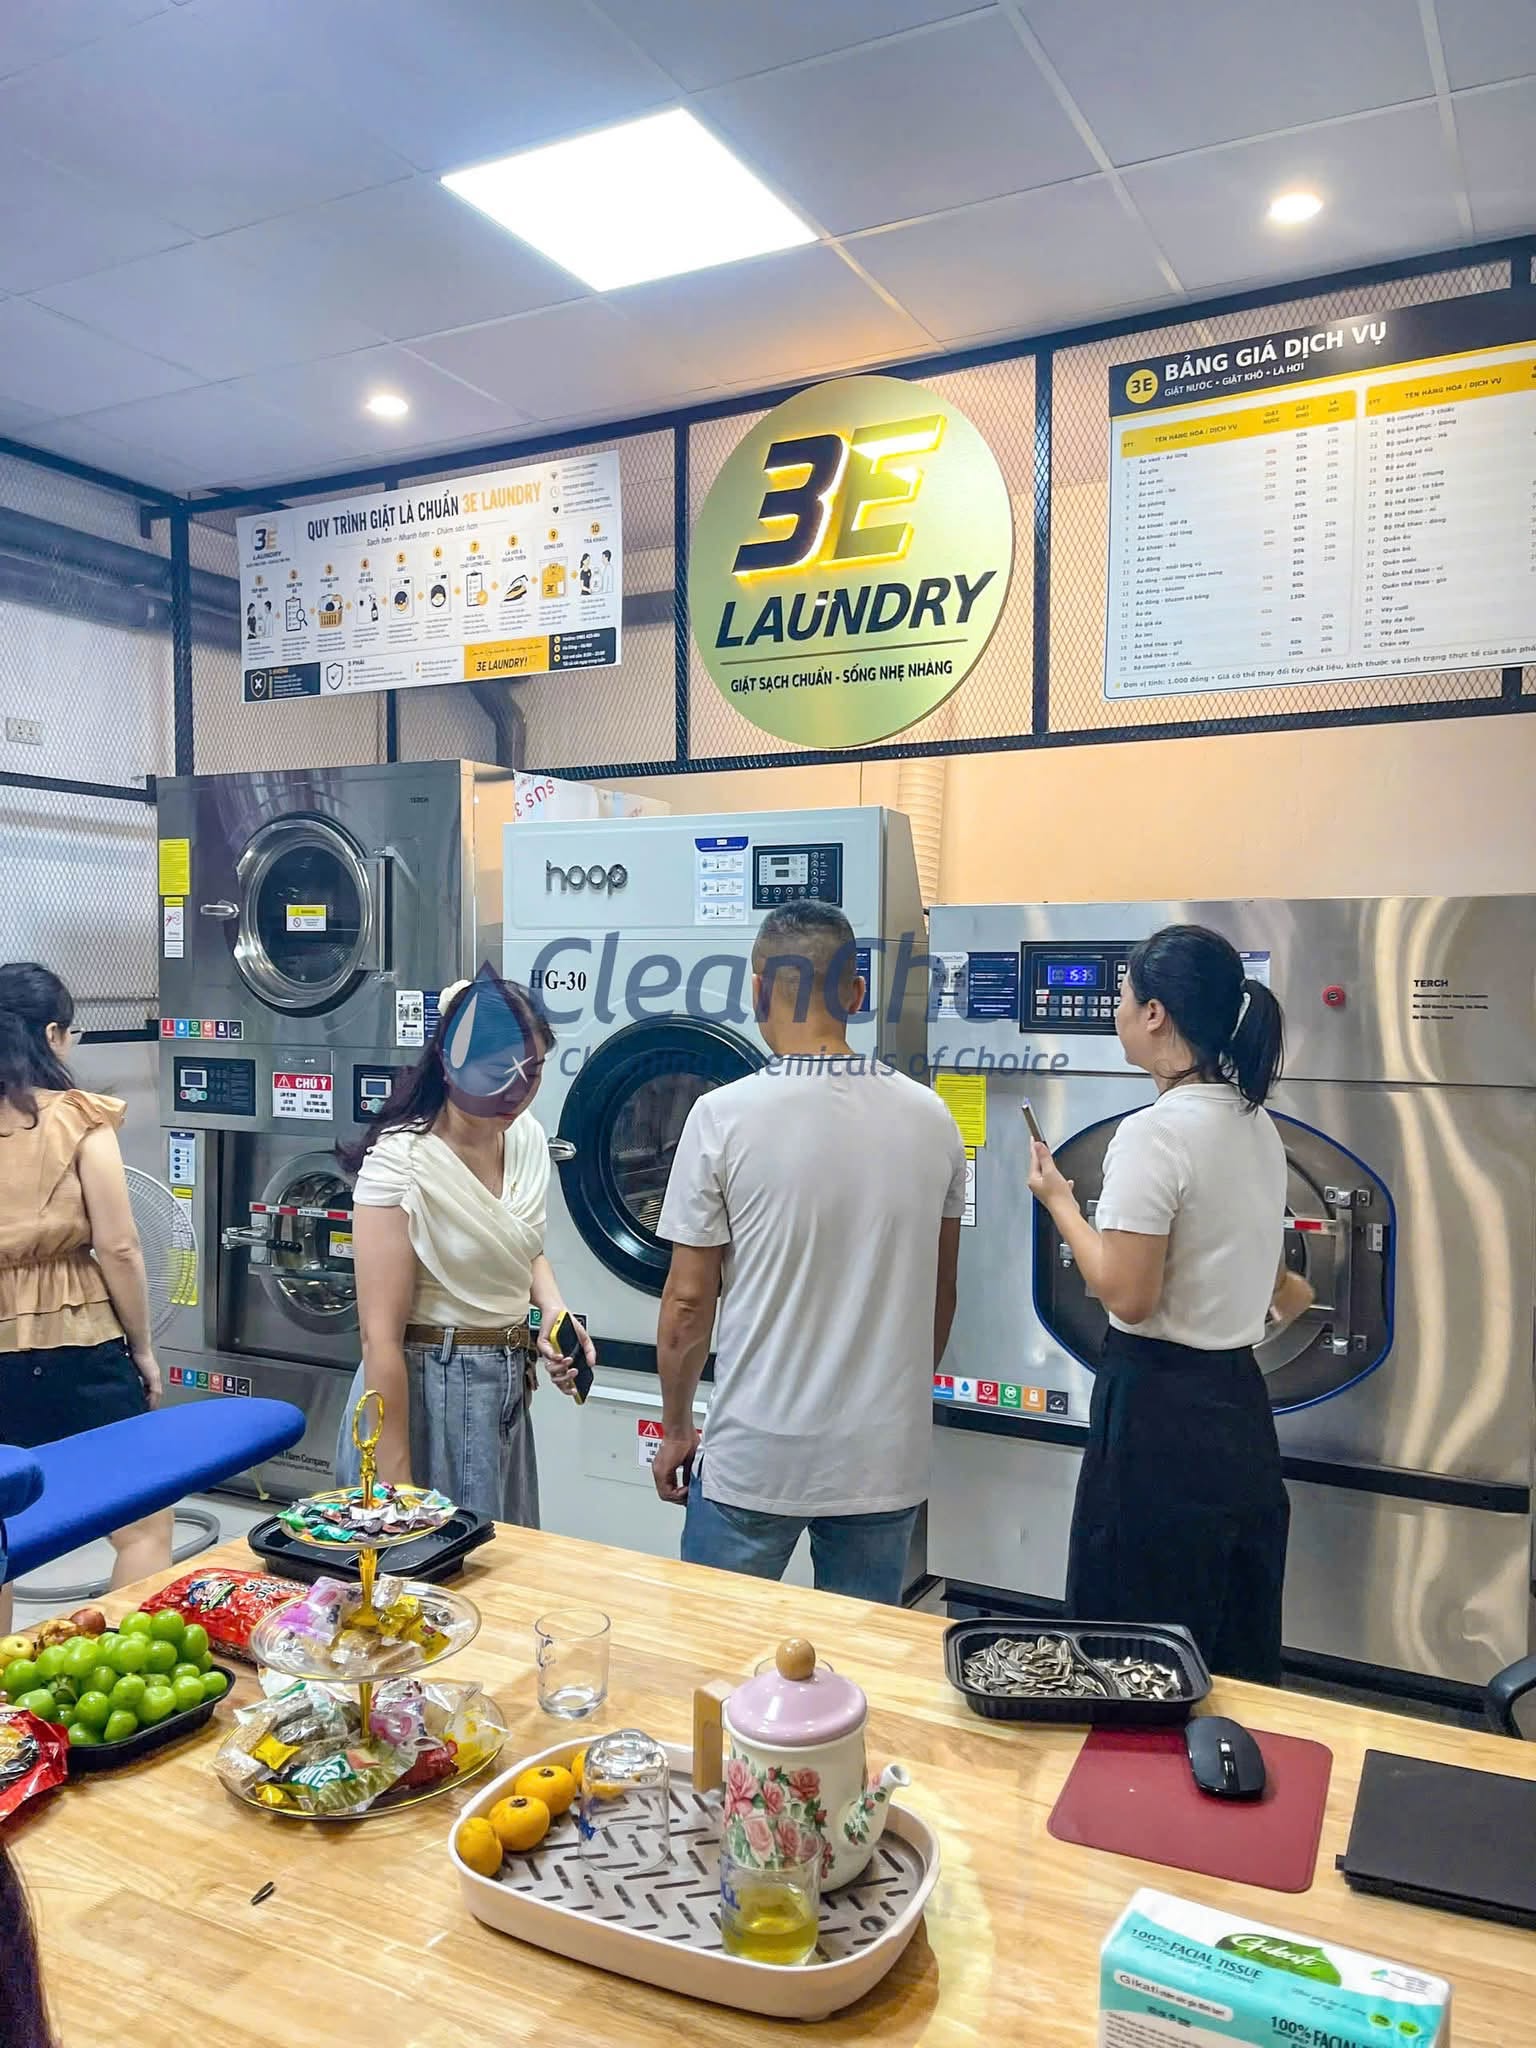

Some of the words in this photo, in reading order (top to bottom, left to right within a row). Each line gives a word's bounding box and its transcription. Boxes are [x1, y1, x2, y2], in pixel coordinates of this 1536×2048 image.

[1165, 351, 1228, 382] BẢNG
[1236, 340, 1278, 367] GIÁ
[1284, 330, 1344, 362] DỊCH
[1351, 321, 1386, 348] VỤ
[1131, 378, 1153, 394] 3E
[1164, 386, 1184, 397] GIẶT
[1186, 379, 1213, 393] NƯỚC
[1222, 374, 1242, 387] GIẶT
[1244, 370, 1264, 381] KHÔ
[1272, 366, 1285, 376] LÀ
[1286, 362, 1304, 373] HƠI
[308, 518, 330, 542] QUY
[333, 510, 367, 536] TRÌNH
[370, 504, 396, 532] GIẶT
[399, 500, 414, 524] LÀ
[463, 492, 478, 514] 3E
[482, 482, 542, 511] LAUNDRY
[731, 414, 946, 578] 3E
[715, 570, 998, 648] LAUNDRY
[476, 662, 486, 672] 3E
[488, 656, 528, 670] LAUNDRY!
[731, 674, 757, 696] GIẶT
[760, 673, 789, 694] SẠCH
[792, 665, 832, 688] CHUẨN
[843, 662, 876, 684] SỐNG
[880, 664, 905, 682] NHẸ
[908, 658, 952, 678] NHÀNG
[1190, 675, 1209, 683] đồng
[1258, 669, 1274, 678] thay
[1306, 664, 1324, 672] chất
[1326, 663, 1344, 671] liệu,
[1404, 656, 1421, 664] tình
[1423, 654, 1447, 663] trạng
[544, 858, 629, 899] hoop
[530, 968, 586, 991] HG-30
[1414, 980, 1448, 988] TERCH
[295, 1076, 318, 1089] CHÚ
[320, 1076, 327, 1090] Ý
[1132, 1928, 1170, 1946] 100%
[1170, 1942, 1214, 1965] FACIAL
[1218, 1958, 1264, 1980] TISSUE
[1272, 2016, 1312, 2039] 100%
